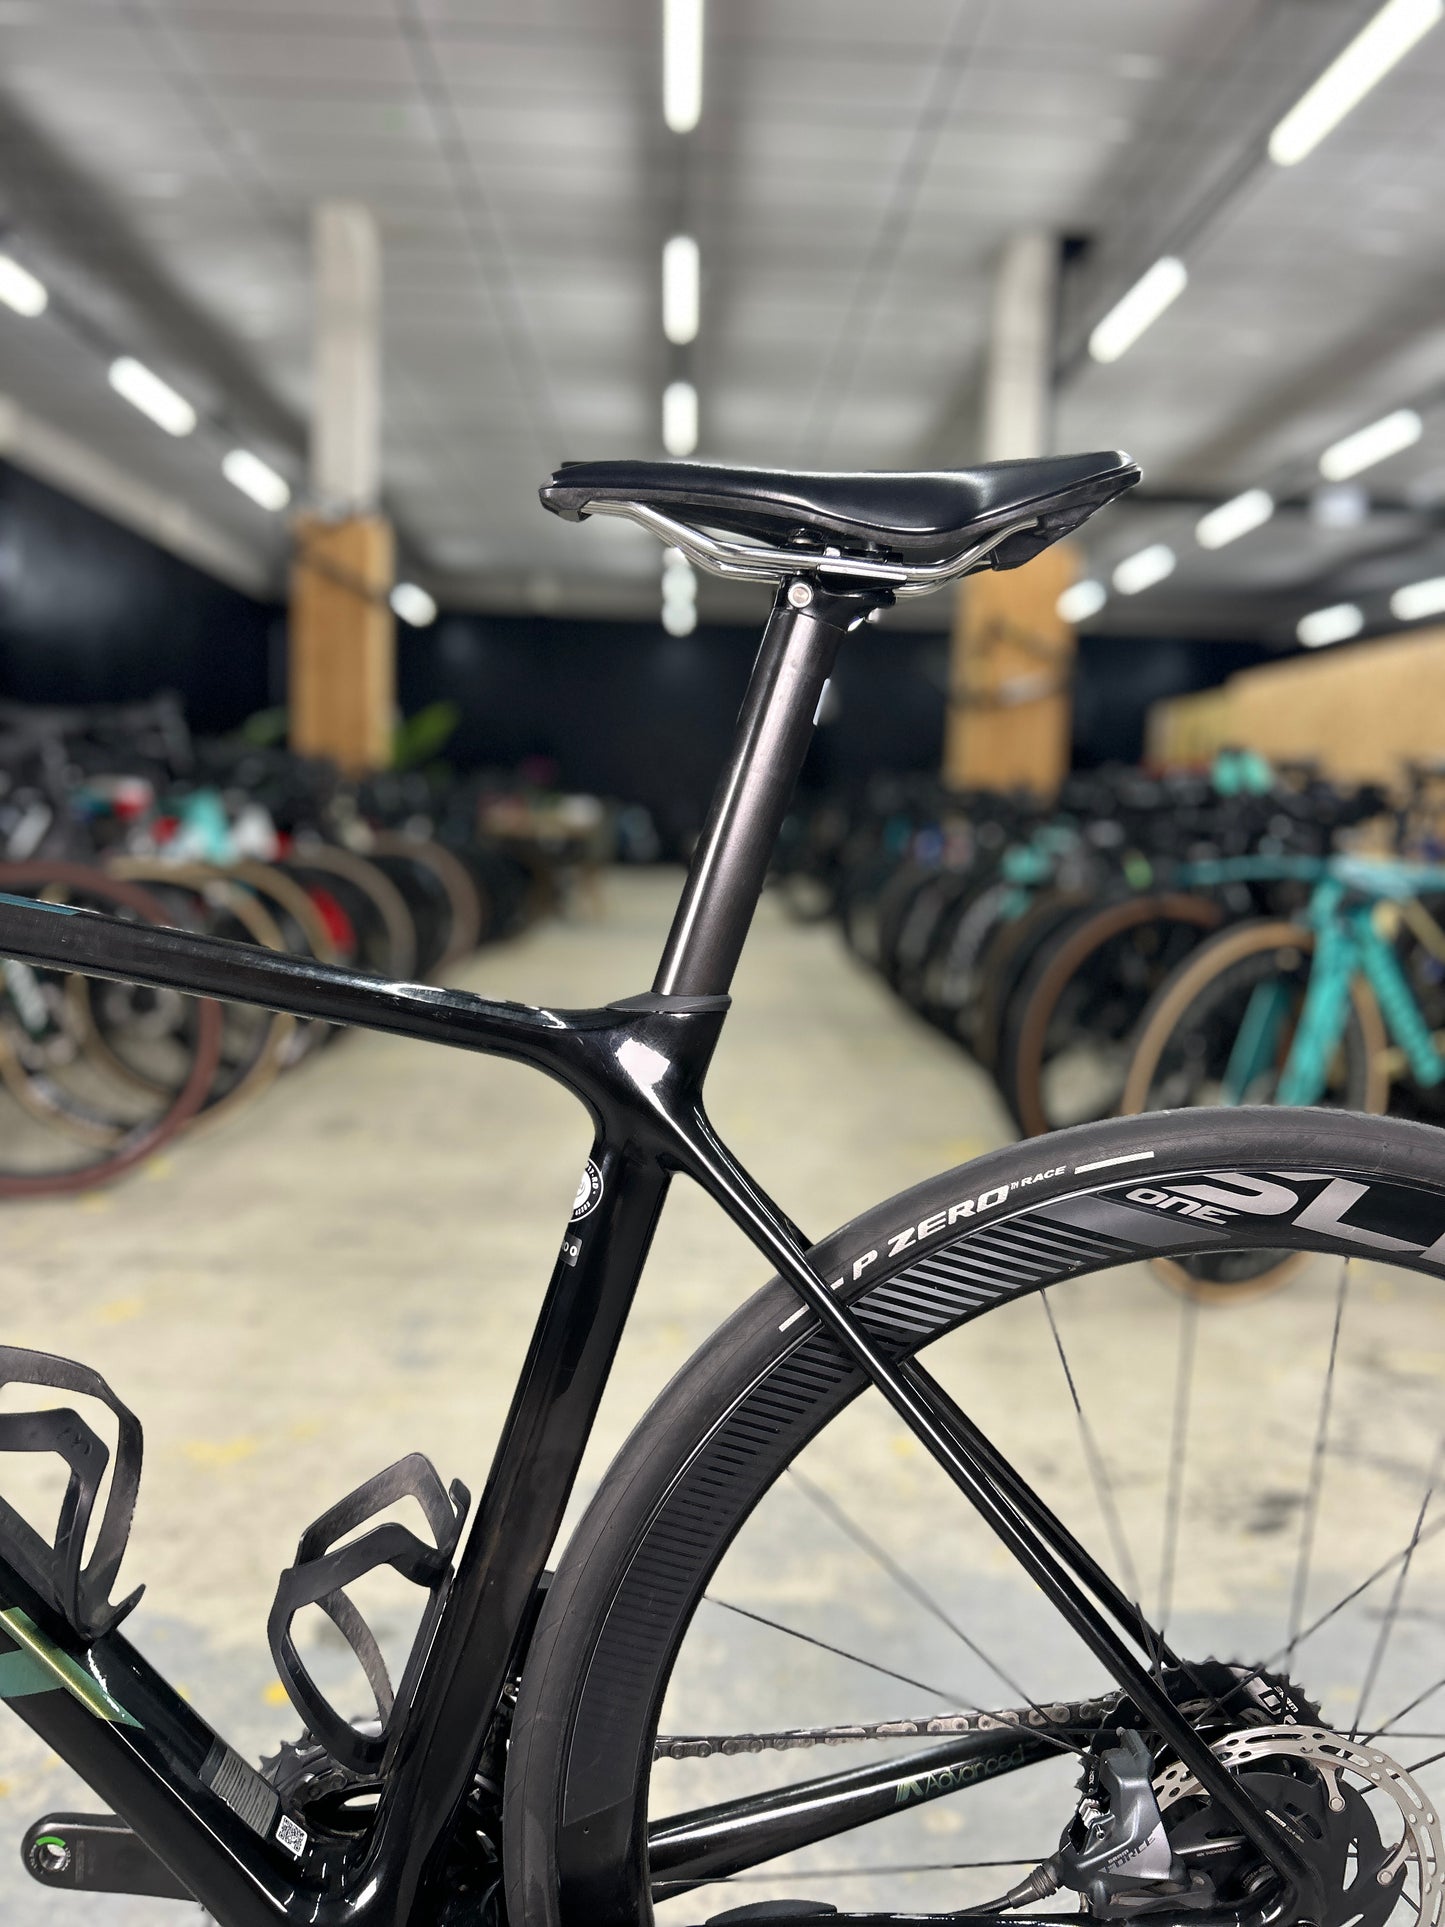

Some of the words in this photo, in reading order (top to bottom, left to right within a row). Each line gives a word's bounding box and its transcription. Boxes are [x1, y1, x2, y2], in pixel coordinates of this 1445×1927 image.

[852, 1249, 878, 1281] P
[887, 1185, 1009, 1258] ZERO
[1020, 1165, 1067, 1187] RACE
[1125, 1187, 1241, 1225] ONE
[925, 1743, 1025, 1796] Advanced
[1104, 1837, 1156, 1874] FORCE
